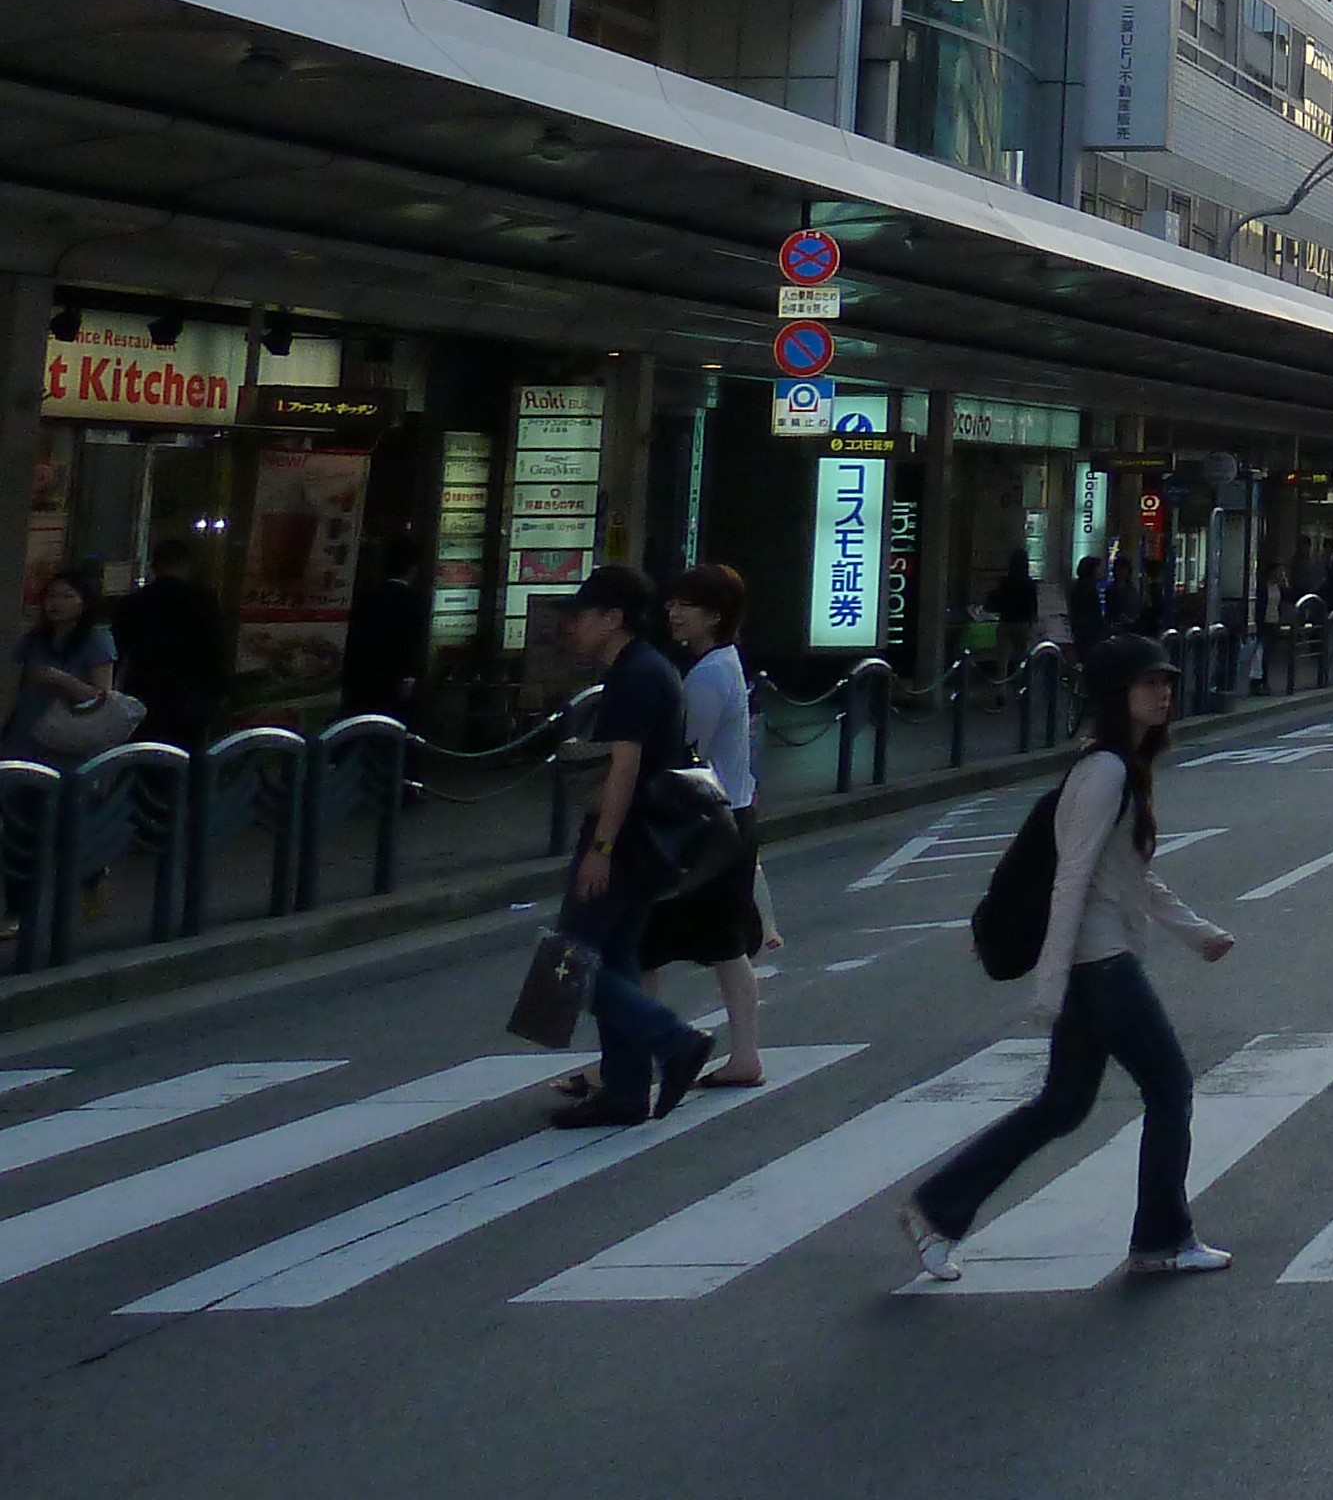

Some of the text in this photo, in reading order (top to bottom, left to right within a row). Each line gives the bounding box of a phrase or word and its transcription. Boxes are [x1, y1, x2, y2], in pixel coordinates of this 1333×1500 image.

[79, 355, 228, 410] Kitchen
[844, 439, 895, 452] コスモ証券
[1083, 470, 1098, 534] docomo
[829, 464, 866, 627] コスモ証券
